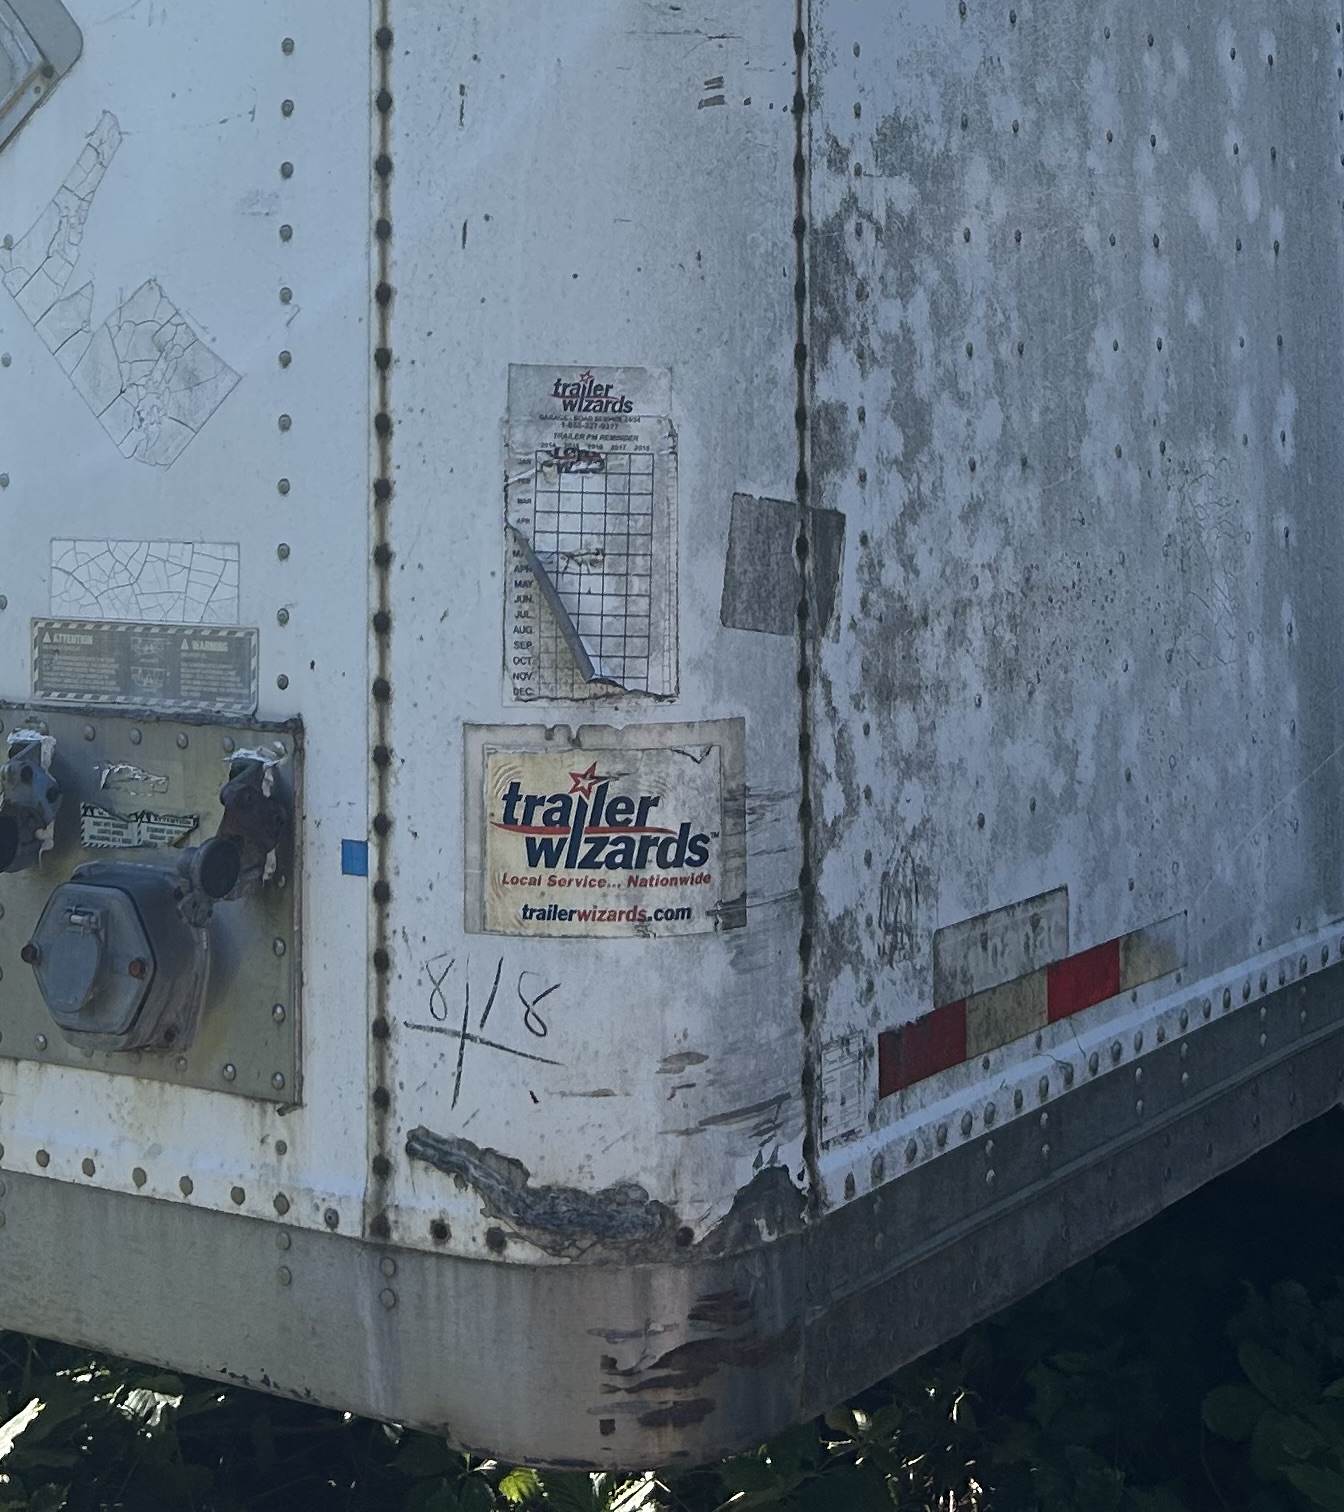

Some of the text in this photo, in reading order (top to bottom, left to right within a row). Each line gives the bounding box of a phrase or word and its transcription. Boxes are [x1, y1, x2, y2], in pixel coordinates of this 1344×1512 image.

[553, 377, 614, 398] trailer
[562, 396, 634, 413] wizards
[502, 781, 661, 828] trailer
[525, 822, 710, 870] wizards
[502, 872, 712, 889] Local Service... Nationwide
[522, 904, 692, 923] trailerwizards.com
